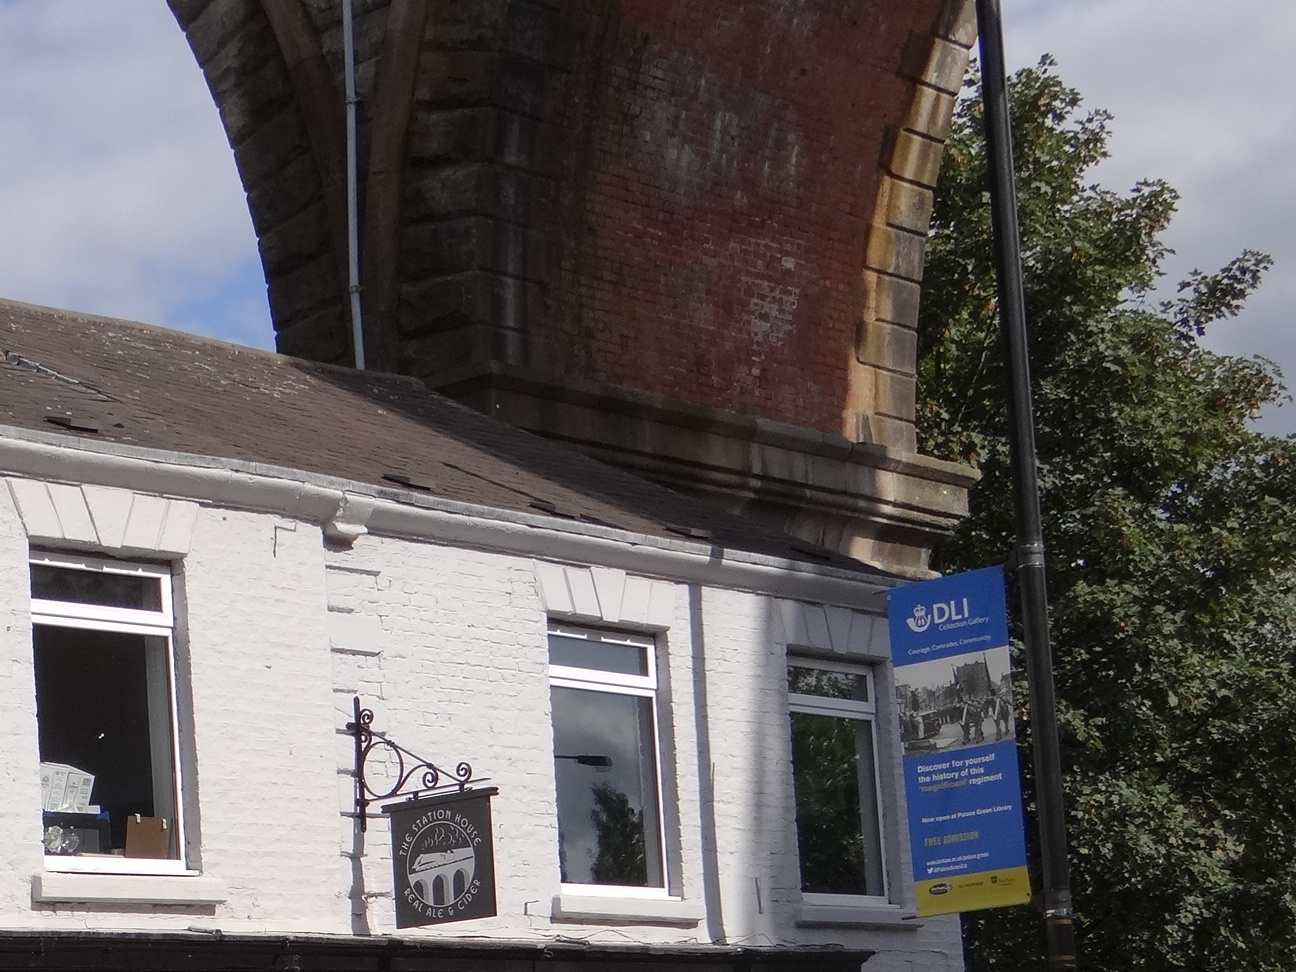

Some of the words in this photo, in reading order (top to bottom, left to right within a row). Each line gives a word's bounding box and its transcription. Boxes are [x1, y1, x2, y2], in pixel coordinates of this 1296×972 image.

[932, 597, 969, 624] DLI
[938, 620, 968, 632] Collection
[968, 616, 990, 626] Gallery
[959, 634, 991, 646] Community
[917, 762, 950, 774] Discover
[951, 759, 964, 768] for
[965, 753, 995, 768] yourself
[918, 775, 931, 784] the
[932, 771, 959, 782] history
[960, 768, 969, 777] of
[969, 766, 985, 775] this
[968, 772, 1003, 786] regiment
[921, 816, 935, 824] Now
[935, 814, 951, 822] open
[957, 811, 976, 819] Palace
[976, 807, 993, 815] Green
[993, 804, 1013, 813] Library
[399, 833, 413, 857] THE
[412, 809, 452, 832] STATION
[454, 812, 482, 847] HOUSE
[924, 835, 942, 847] FREE
[403, 886, 422, 913] REAL
[425, 907, 444, 919] ALE
[447, 906, 455, 917] &
[457, 878, 482, 910] CIDER
